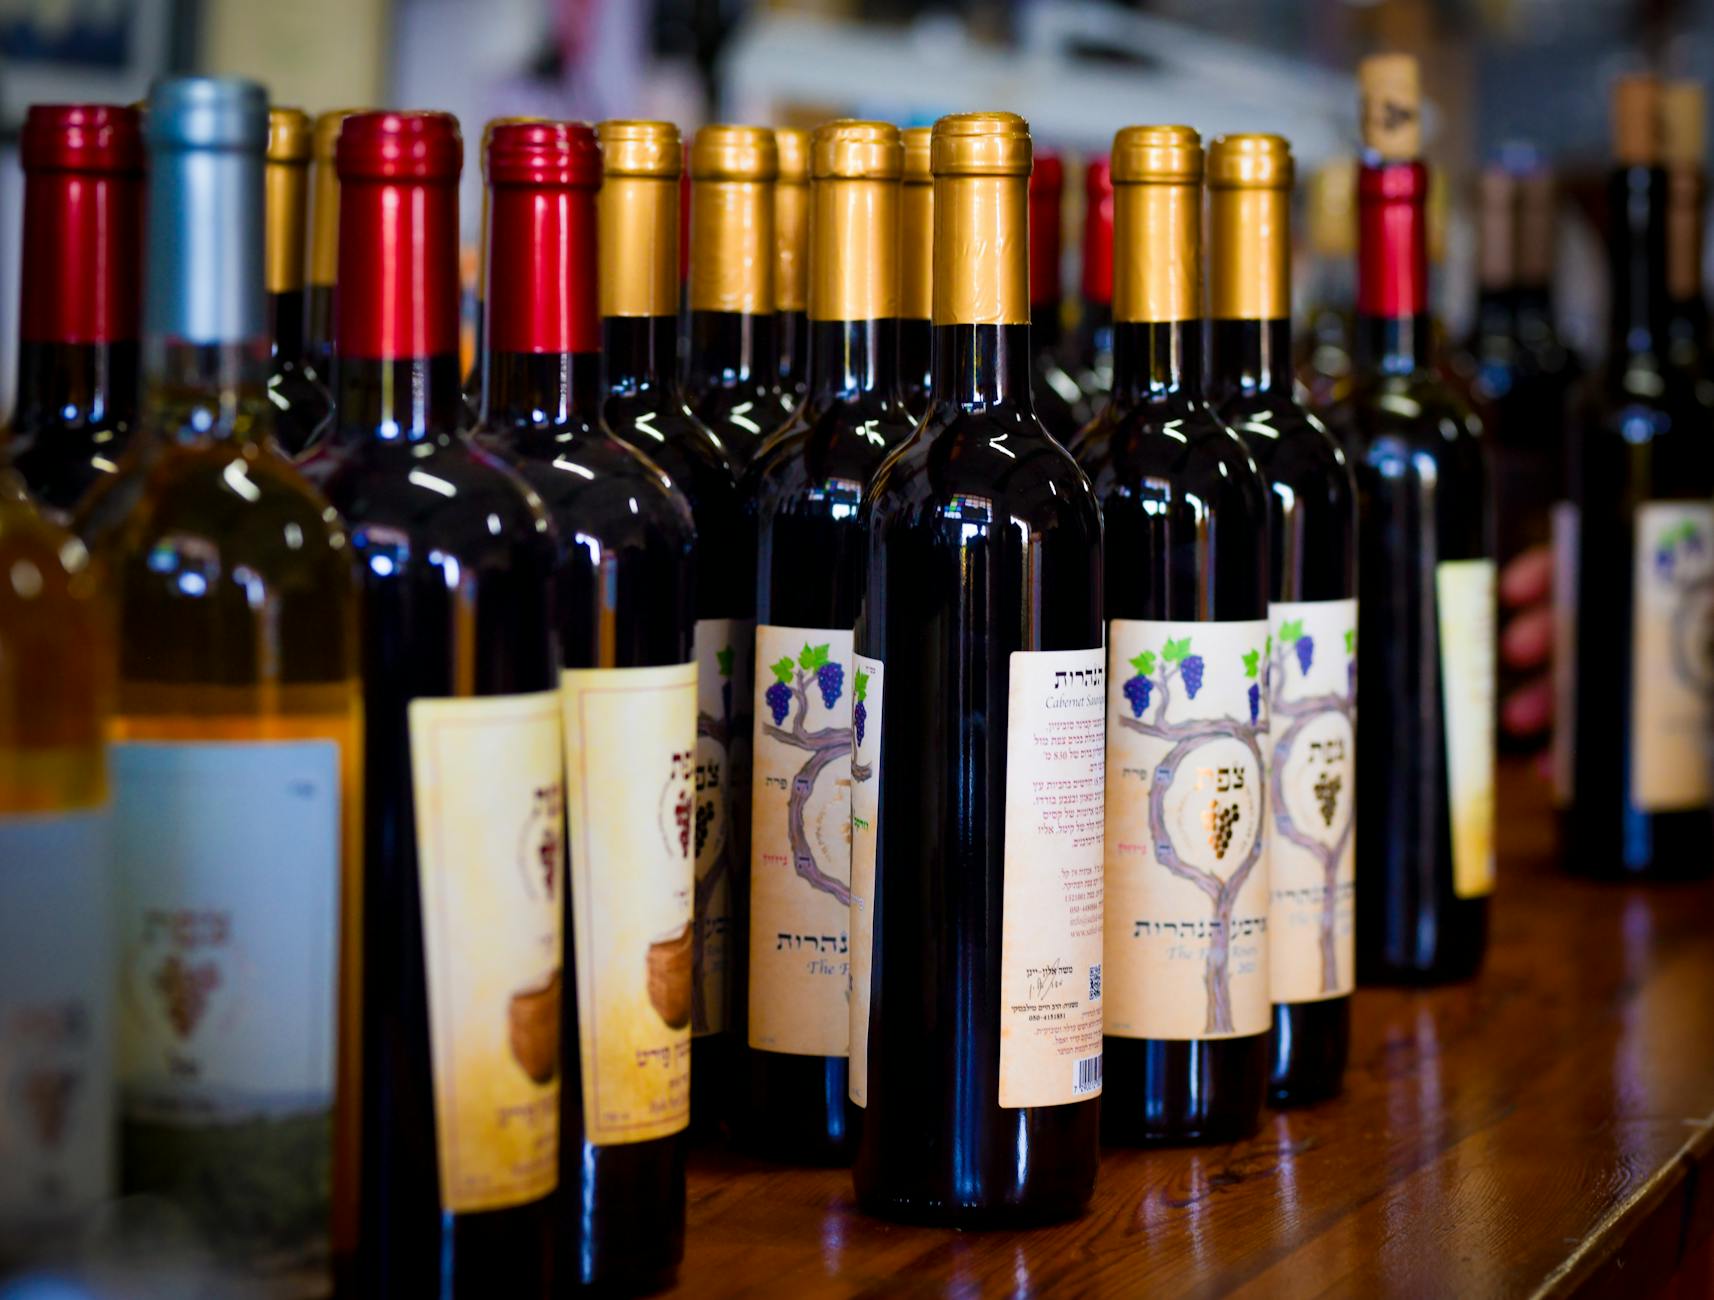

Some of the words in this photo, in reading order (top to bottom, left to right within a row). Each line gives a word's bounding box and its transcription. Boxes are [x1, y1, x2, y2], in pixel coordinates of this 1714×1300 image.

[1046, 694, 1084, 709] Cabernet
[766, 777, 788, 790] פרת
[807, 959, 834, 975] The
